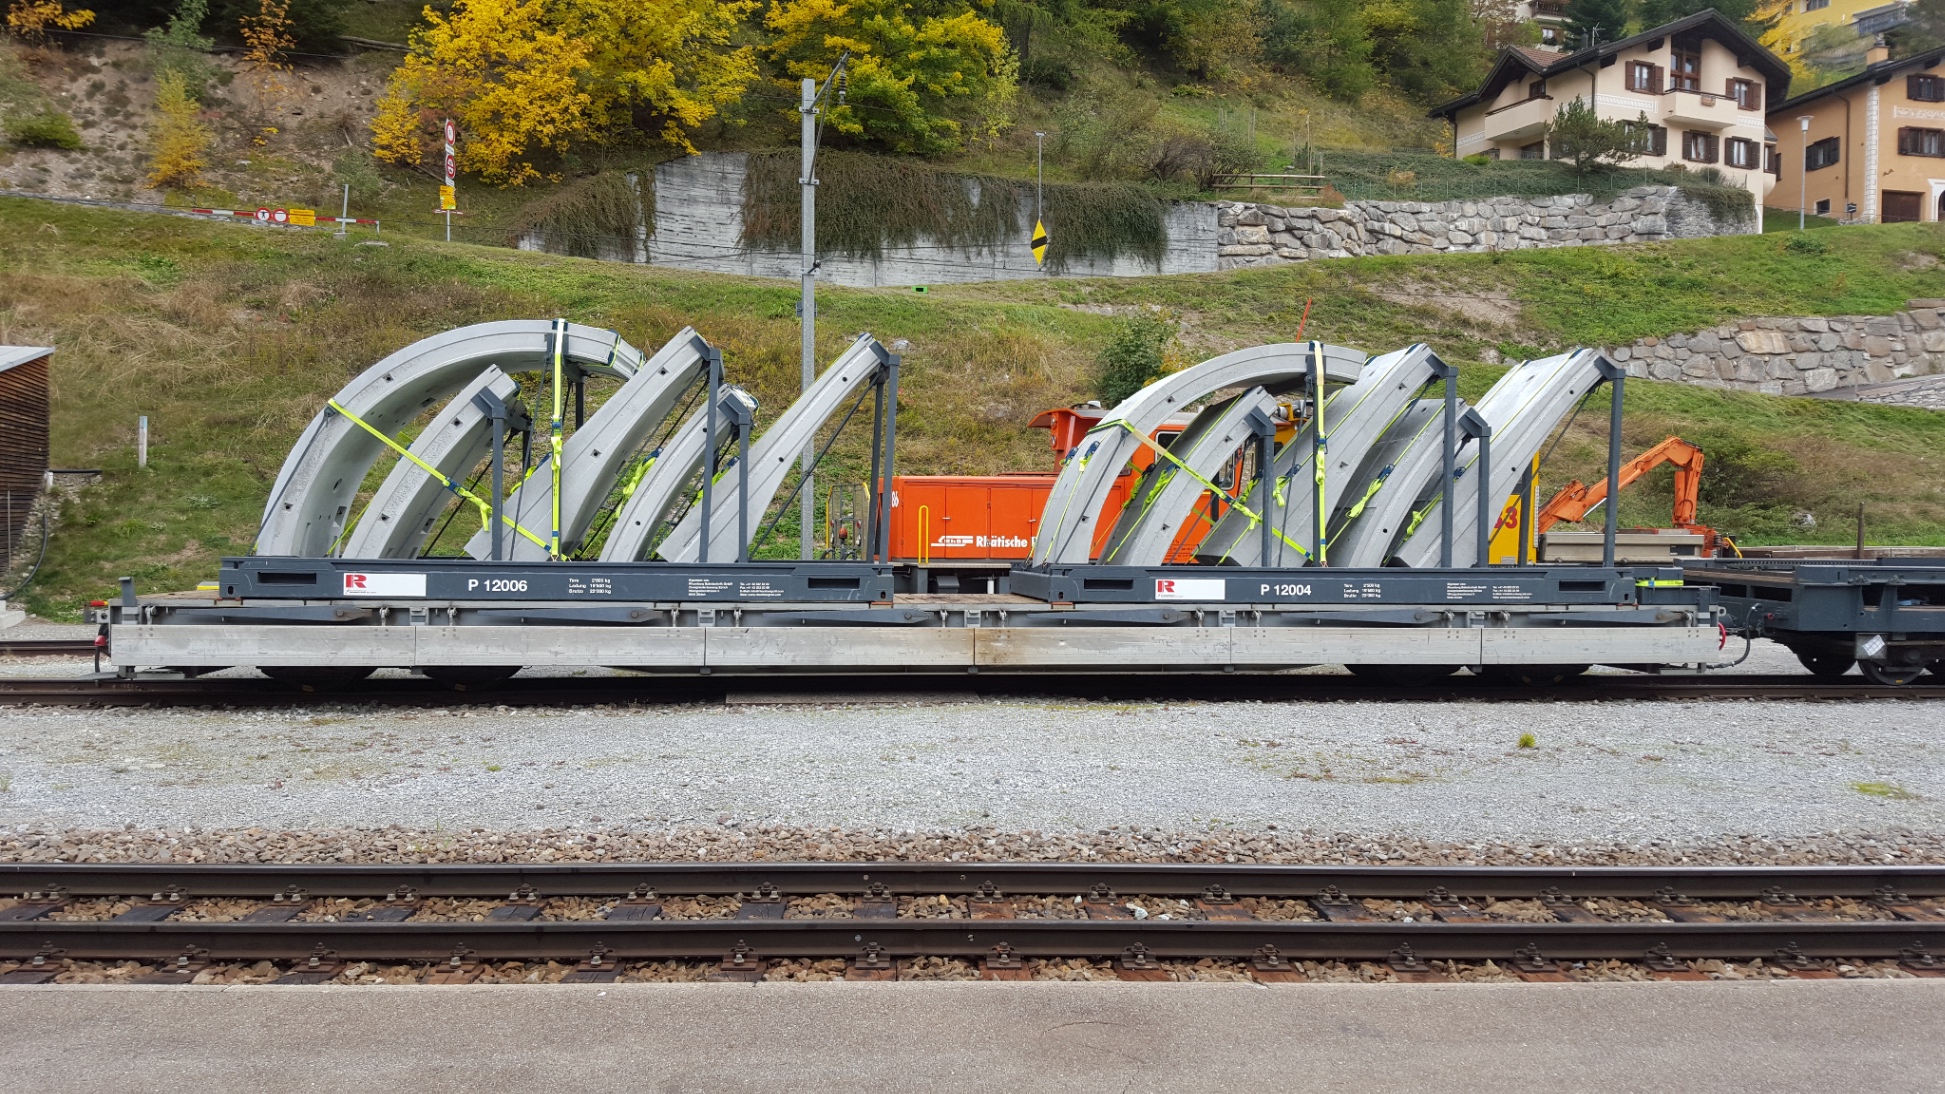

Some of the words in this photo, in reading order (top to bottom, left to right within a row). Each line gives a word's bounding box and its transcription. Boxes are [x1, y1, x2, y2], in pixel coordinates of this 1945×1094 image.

[976, 535, 1028, 548] Rhätische
[468, 579, 479, 592] P
[483, 579, 528, 592] 12006
[1260, 584, 1270, 596] P
[1274, 584, 1312, 596] 12004
